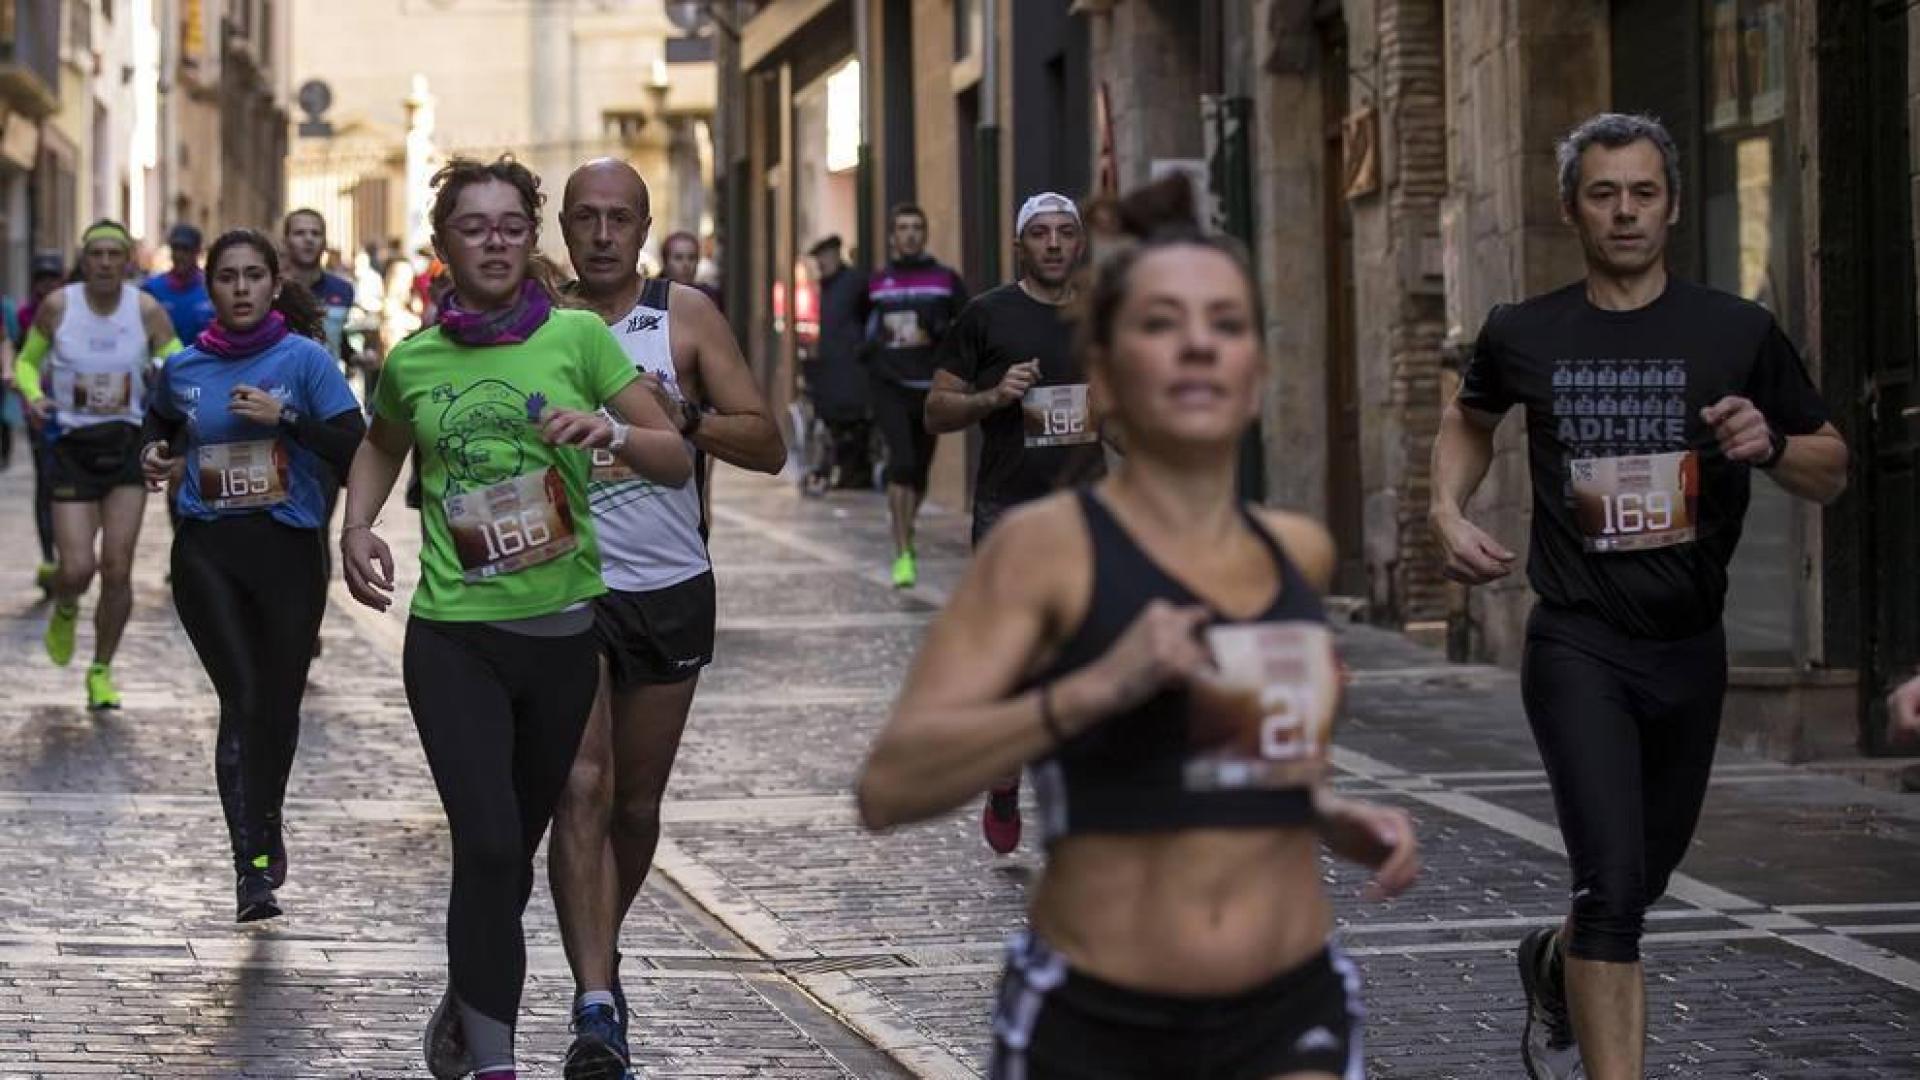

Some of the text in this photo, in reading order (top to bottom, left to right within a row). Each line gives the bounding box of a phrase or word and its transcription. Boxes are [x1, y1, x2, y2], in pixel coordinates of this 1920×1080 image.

[1557, 418, 1686, 441] ADI-IKE
[219, 465, 269, 497] 165
[1601, 491, 1672, 534] 169
[479, 509, 550, 560] 166
